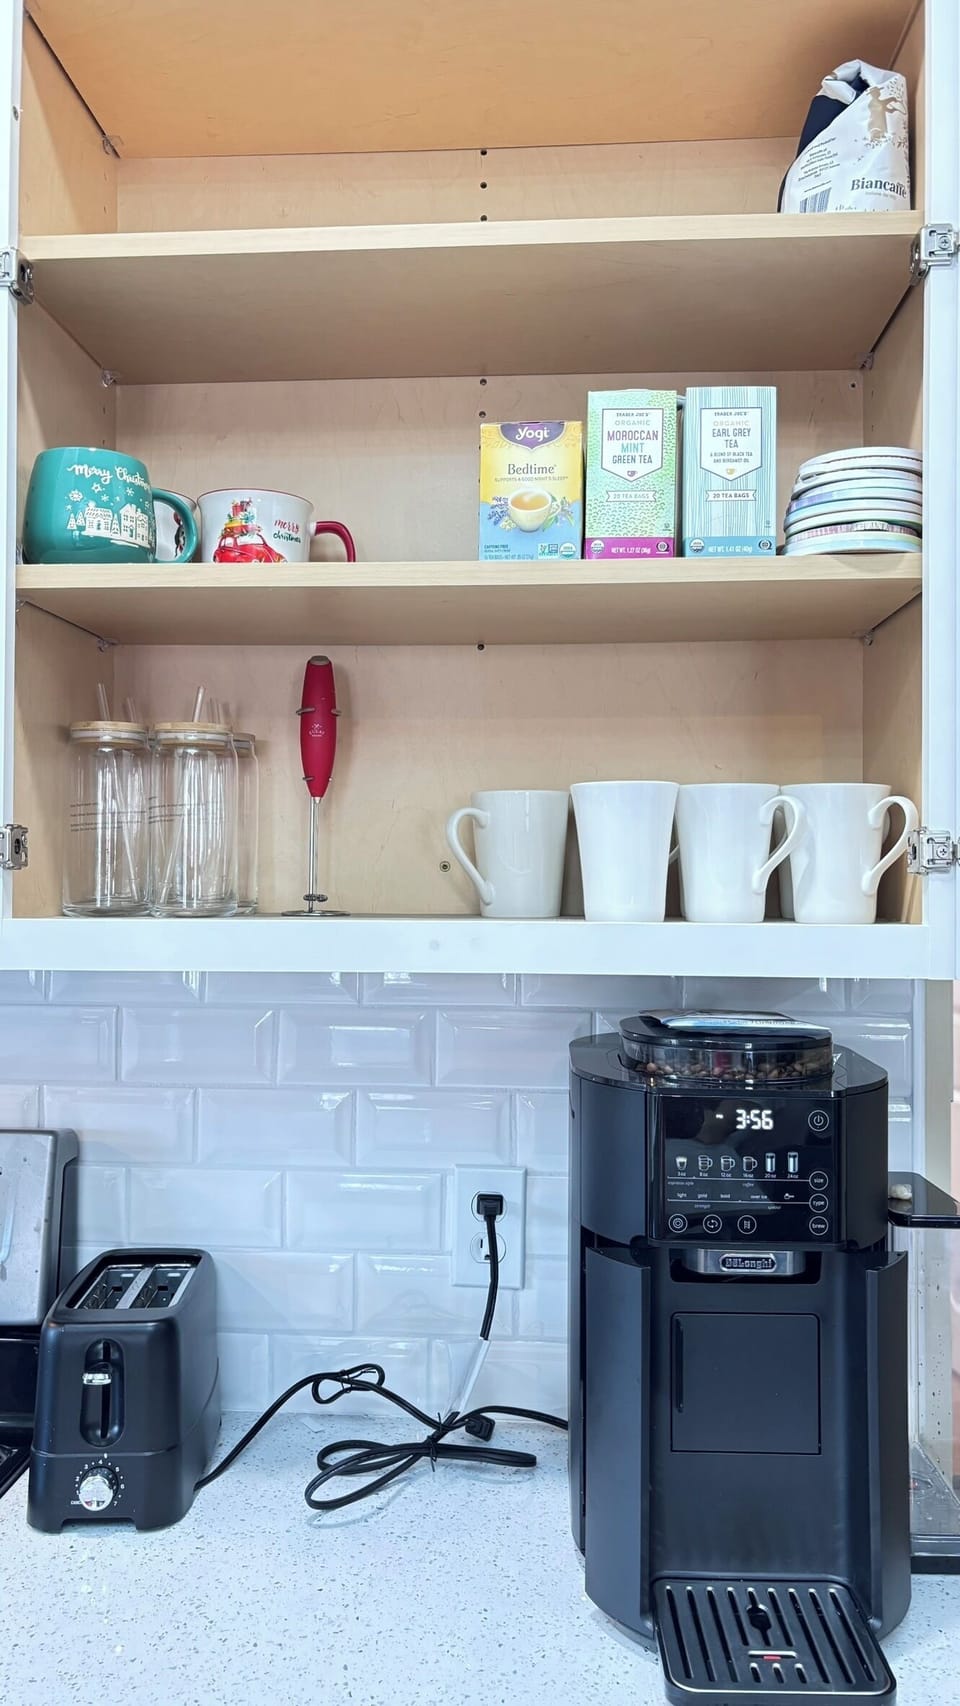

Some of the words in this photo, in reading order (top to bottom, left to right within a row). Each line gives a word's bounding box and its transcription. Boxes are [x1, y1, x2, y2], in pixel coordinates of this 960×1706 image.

[607, 430, 659, 441] MOROCCAN
[712, 428, 730, 438] EARL
[733, 427, 752, 437] GREY
[621, 442, 645, 453] MINT
[724, 439, 739, 448] TEA
[612, 455, 636, 464] GREEN
[638, 454, 653, 464] TEA
[66, 464, 113, 485] Merry
[508, 463, 555, 475] Bedtime
[735, 1109, 774, 1130] 3:56
